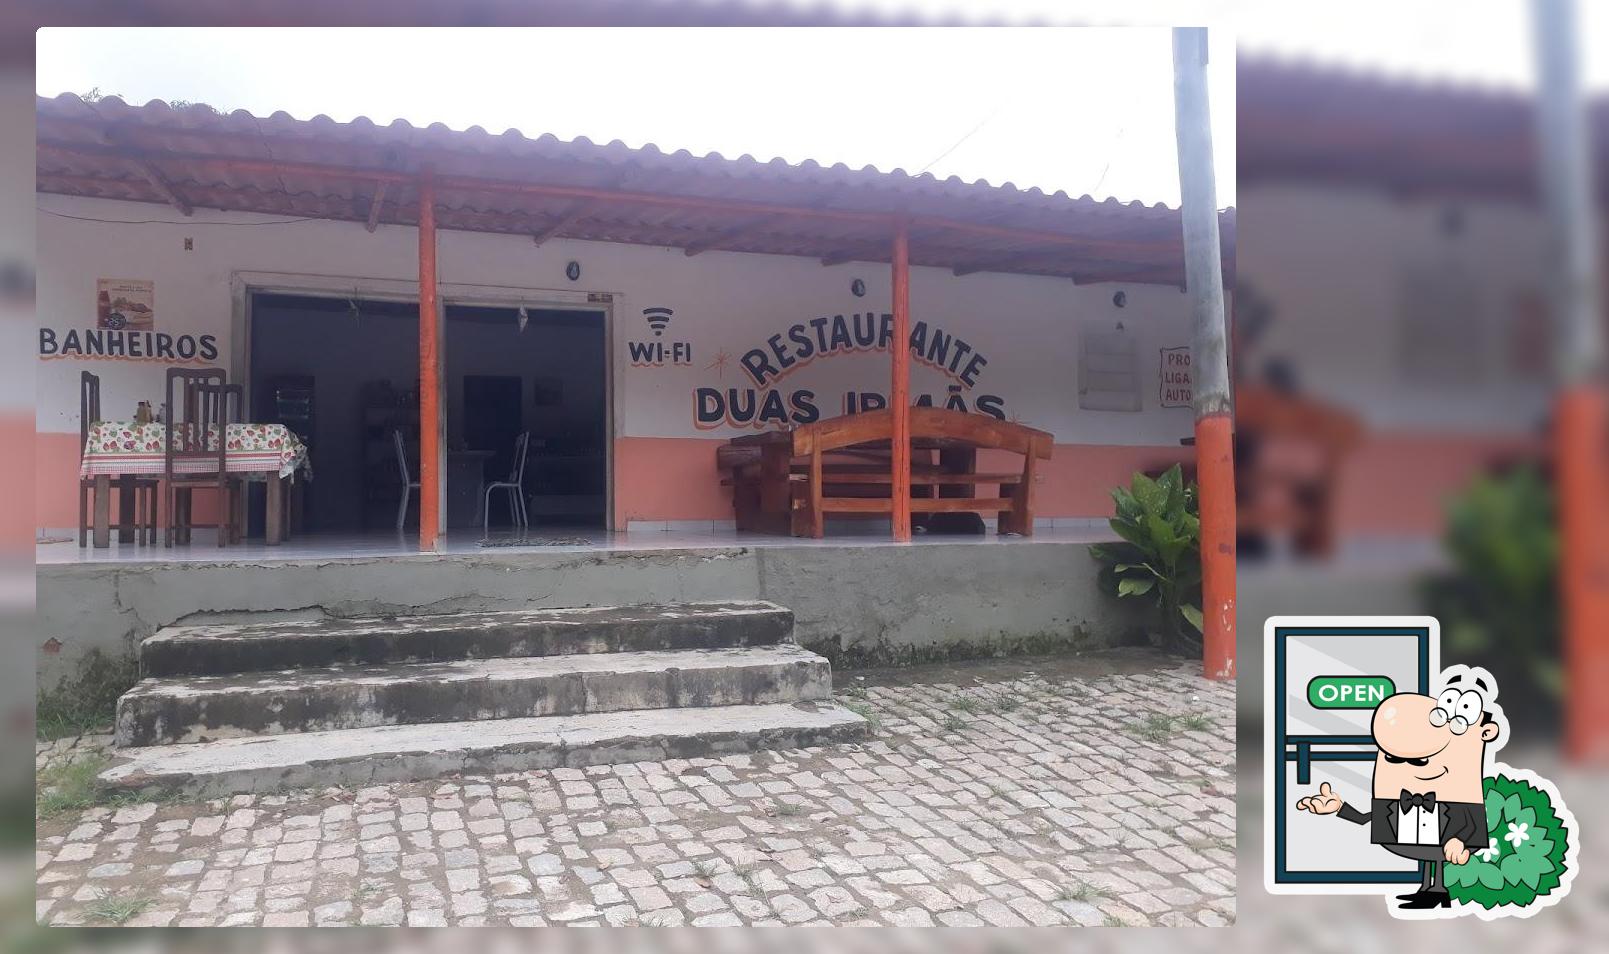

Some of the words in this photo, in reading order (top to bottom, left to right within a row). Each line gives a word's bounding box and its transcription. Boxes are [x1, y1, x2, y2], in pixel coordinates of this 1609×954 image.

[39, 327, 219, 361] BANHEIROS
[628, 341, 692, 363] WI-FI
[1167, 352, 1192, 367] PRO
[1164, 371, 1193, 385] LIGA
[1165, 388, 1192, 402] AUTO
[695, 387, 820, 425] DUAS
